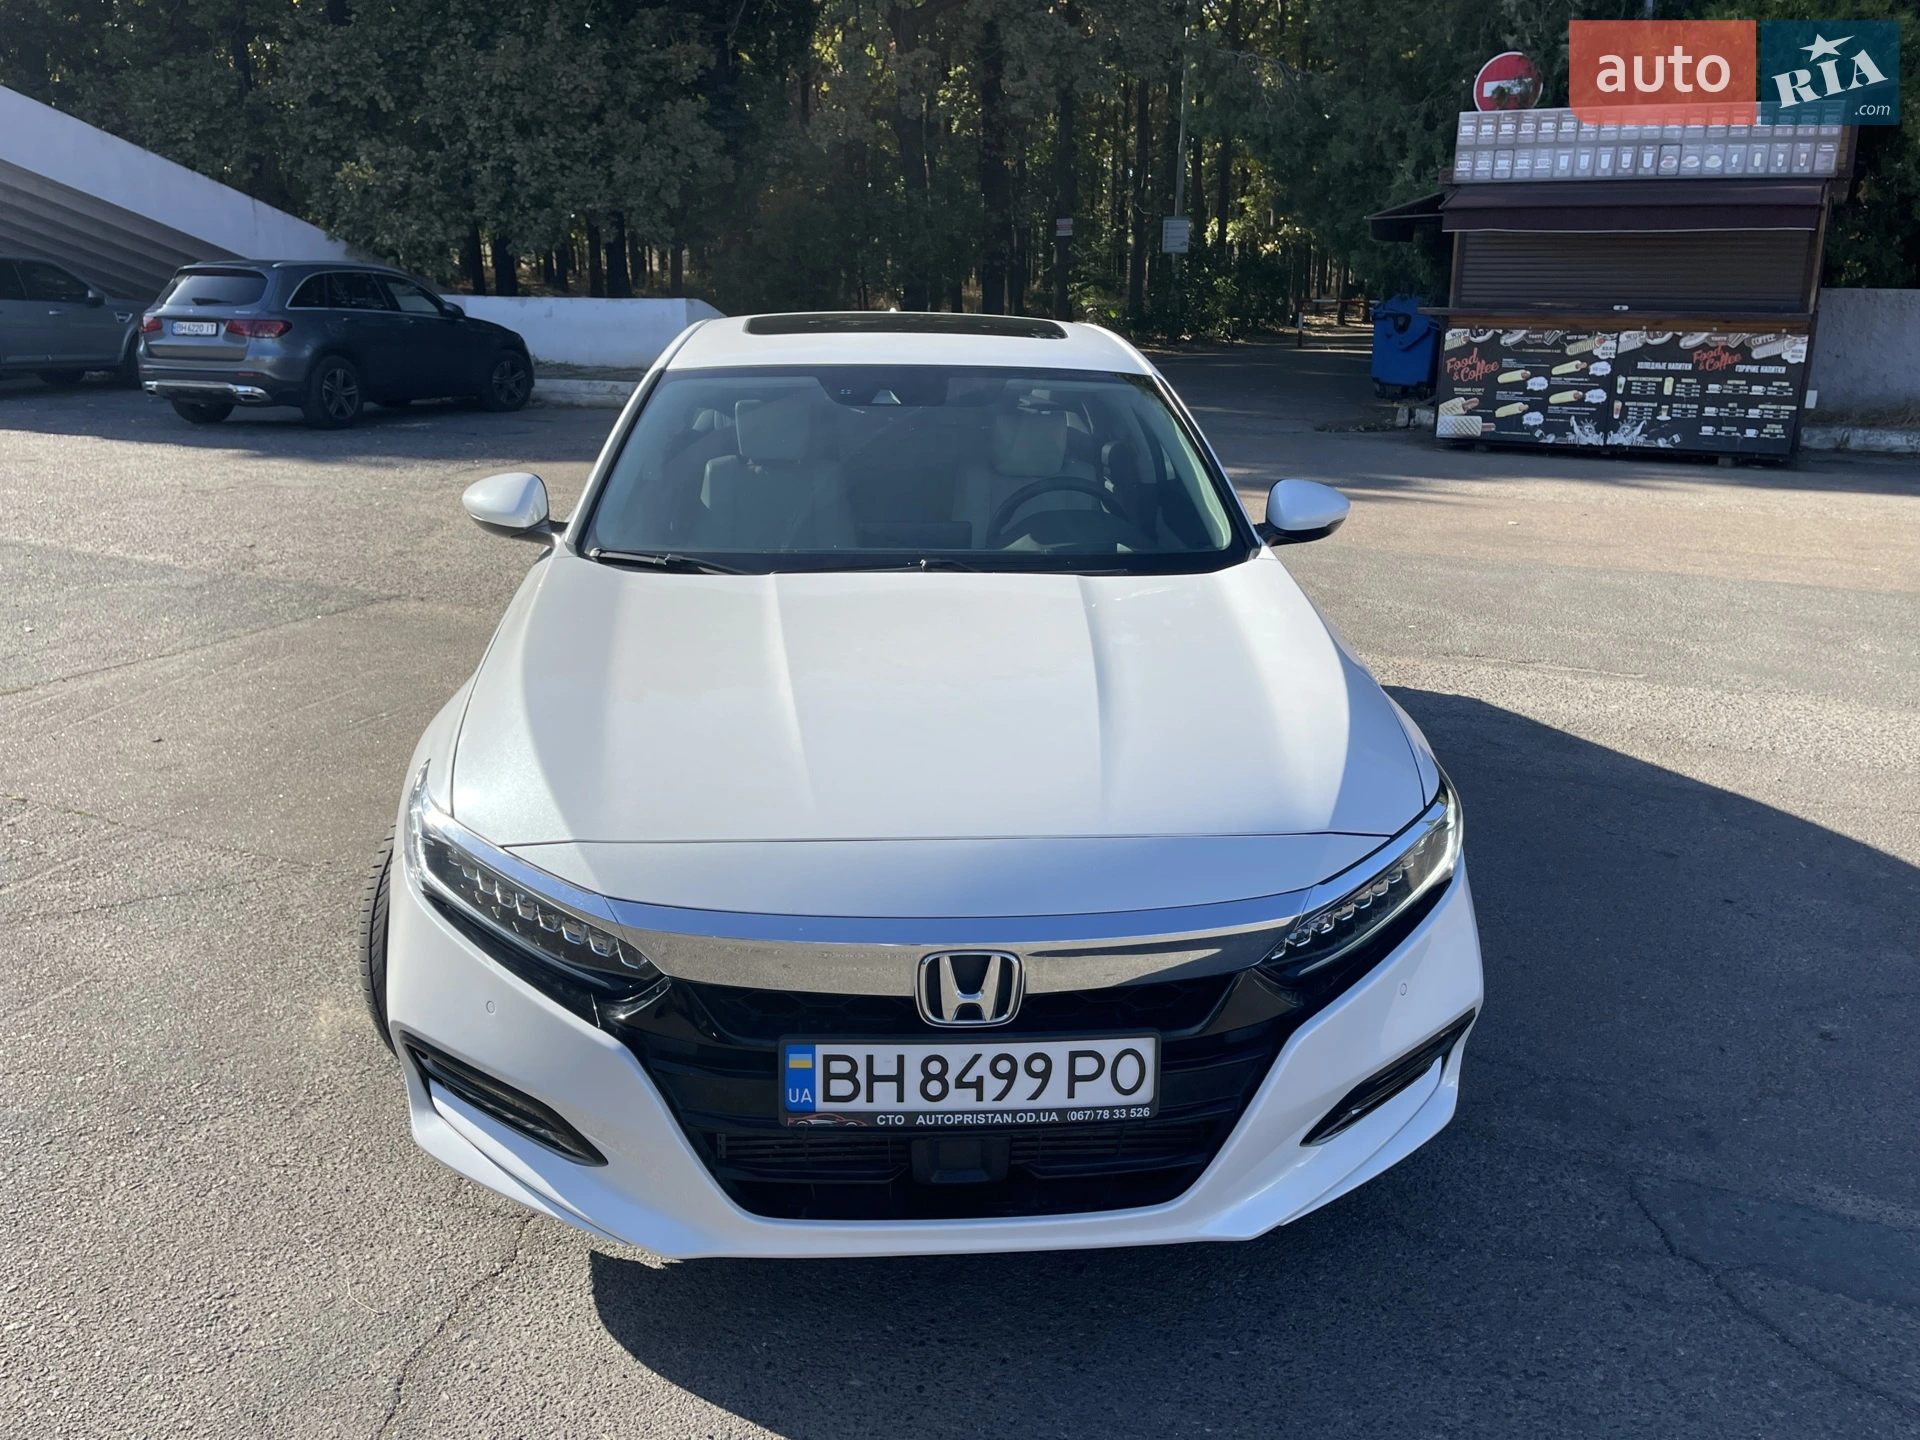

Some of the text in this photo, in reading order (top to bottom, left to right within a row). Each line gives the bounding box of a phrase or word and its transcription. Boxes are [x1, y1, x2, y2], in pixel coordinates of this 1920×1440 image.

[188, 323, 205, 332] 6220
[1751, 333, 1777, 346] COFFEE
[1446, 347, 1478, 374] Food
[1692, 341, 1723, 364] Food
[1705, 351, 1742, 372] Coffee
[1453, 371, 1459, 381] &
[1460, 359, 1500, 382] Coffee
[1667, 362, 1693, 371] НАПИТКИ
[822, 1053, 905, 1103] BH
[919, 1053, 1053, 1103] 8499
[789, 1088, 813, 1104] UA
[916, 1107, 1150, 1126] AUTOPRISTAN.OD.UA (067) 78 33 526
